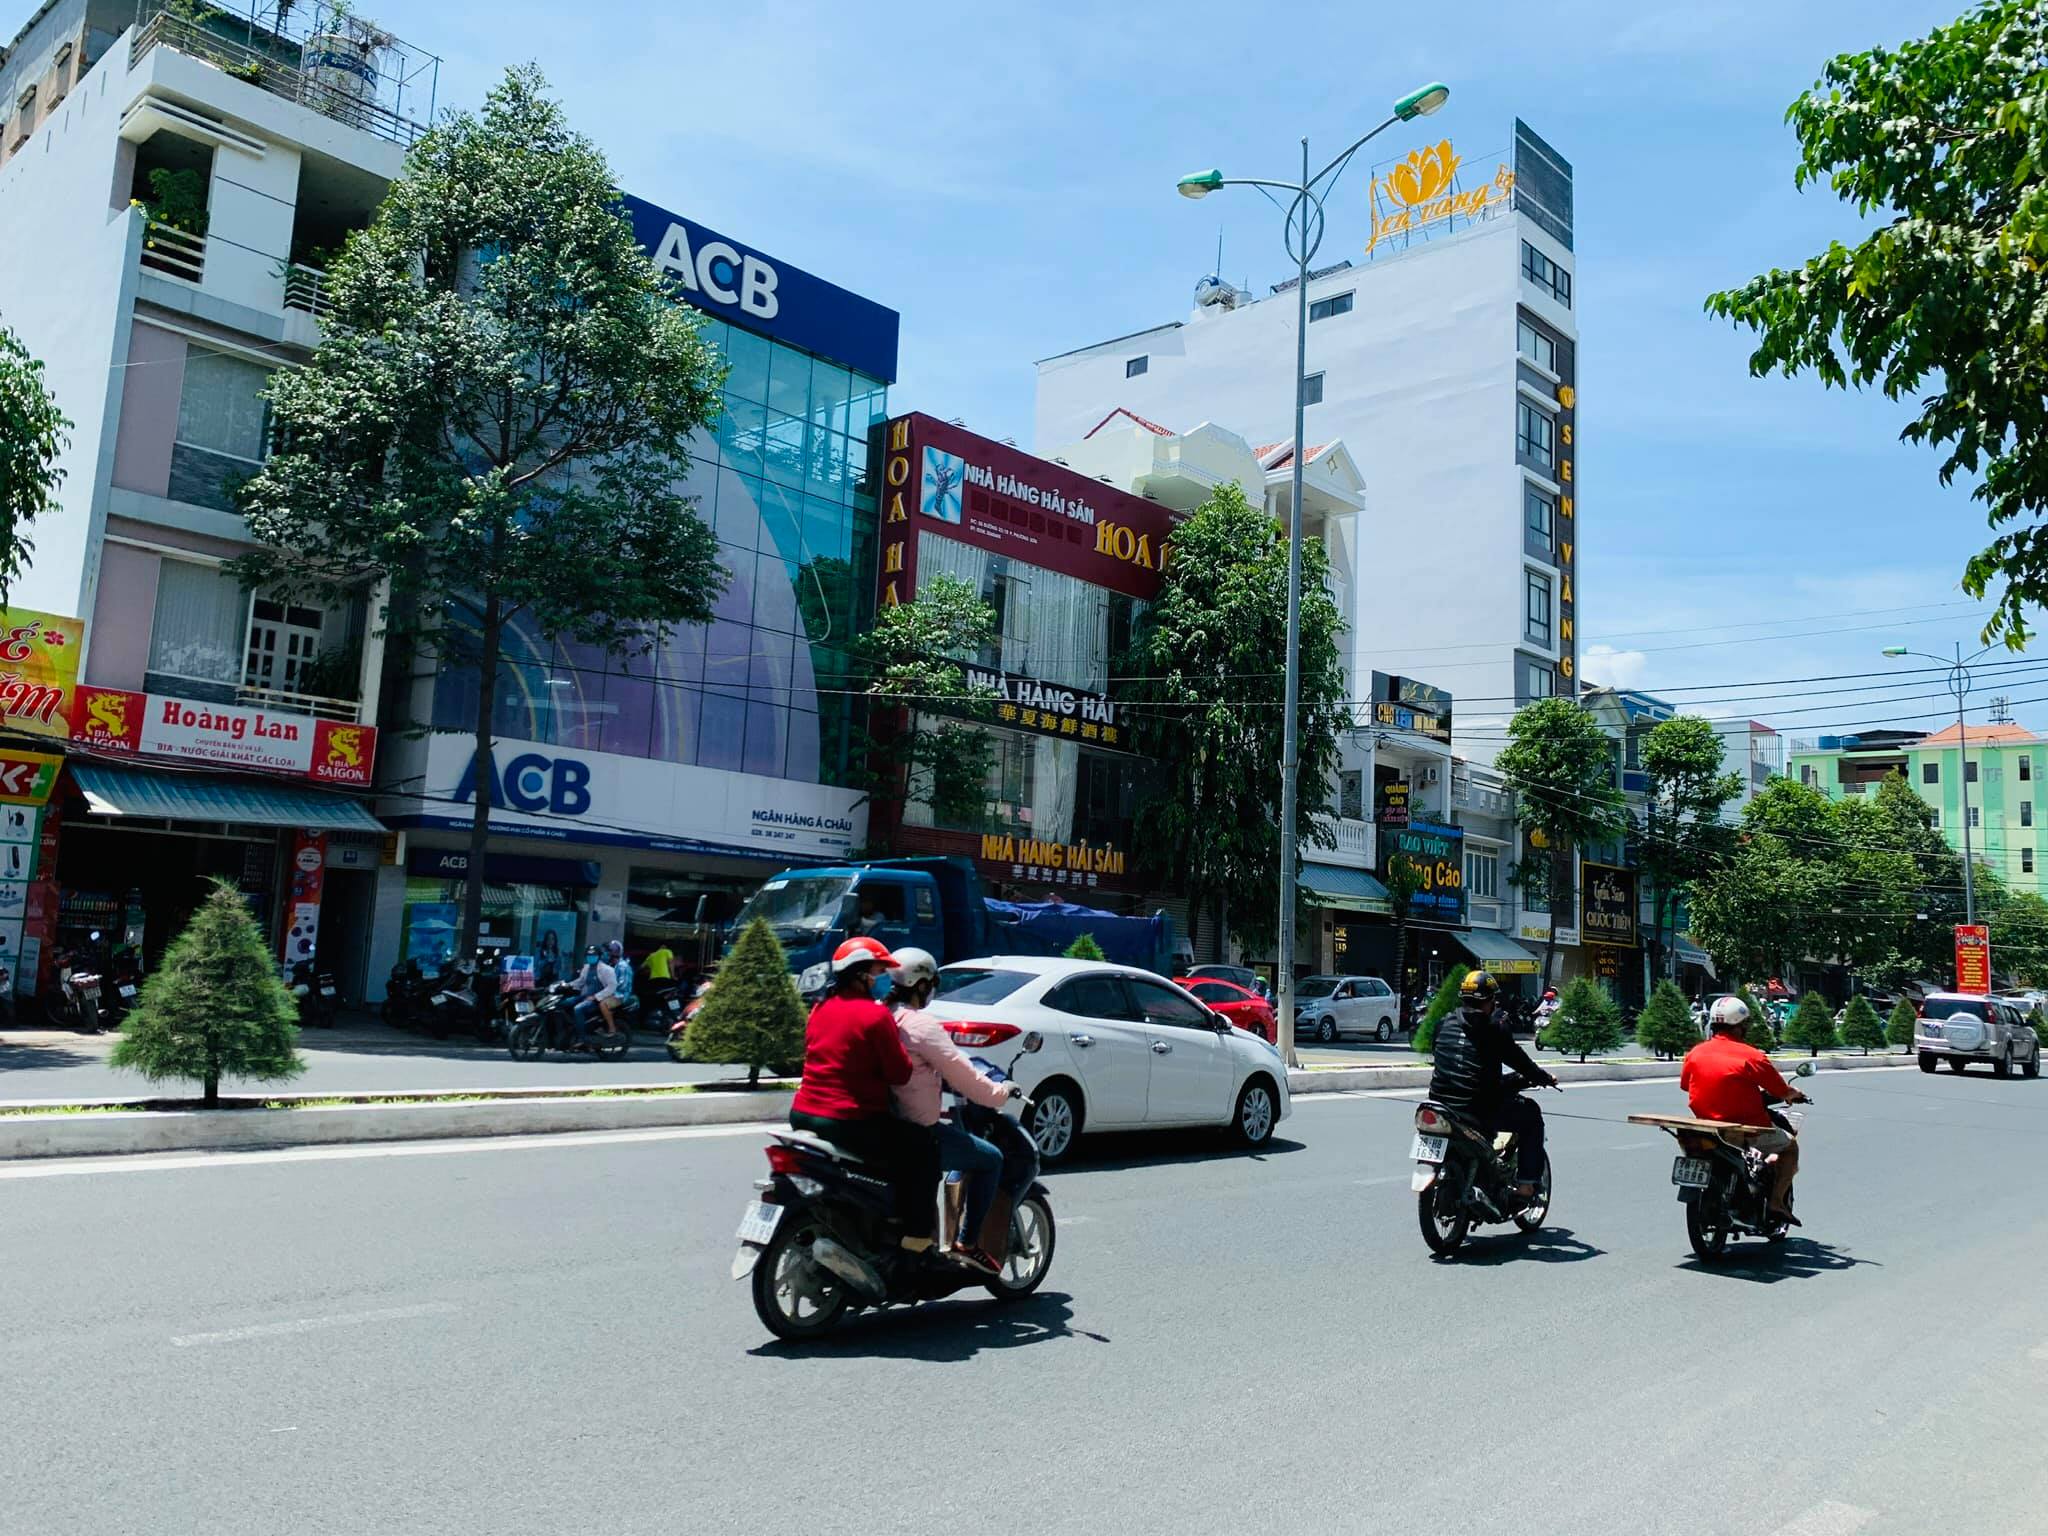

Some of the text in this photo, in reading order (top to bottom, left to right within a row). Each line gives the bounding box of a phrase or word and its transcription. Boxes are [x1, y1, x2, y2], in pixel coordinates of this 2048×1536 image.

[651, 222, 779, 319] ACB
[888, 419, 911, 523] HOA
[1561, 424, 1573, 519] SEN
[964, 463, 1095, 526] NHÀ HÀNG HẢI SẢN
[1093, 519, 1153, 569] HOA
[162, 701, 298, 741] Hoàng Lan
[1016, 679, 1075, 715] HÀNG
[1082, 692, 1114, 724] HẢI
[94, 729, 111, 739] BIA
[157, 743, 173, 752] BIA
[256, 755, 273, 764] CÁC
[317, 765, 365, 781] SAIGON
[335, 760, 349, 768] BIA
[453, 747, 591, 815] ACB
[752, 809, 852, 832] NGÂN HÀNG Á CHÂU
[439, 855, 468, 869] ACB
[981, 832, 1015, 863] NHÀ
[1066, 837, 1093, 871] HẢI
[1095, 842, 1125, 874] SẢN
[1436, 861, 1461, 889] Cáo
